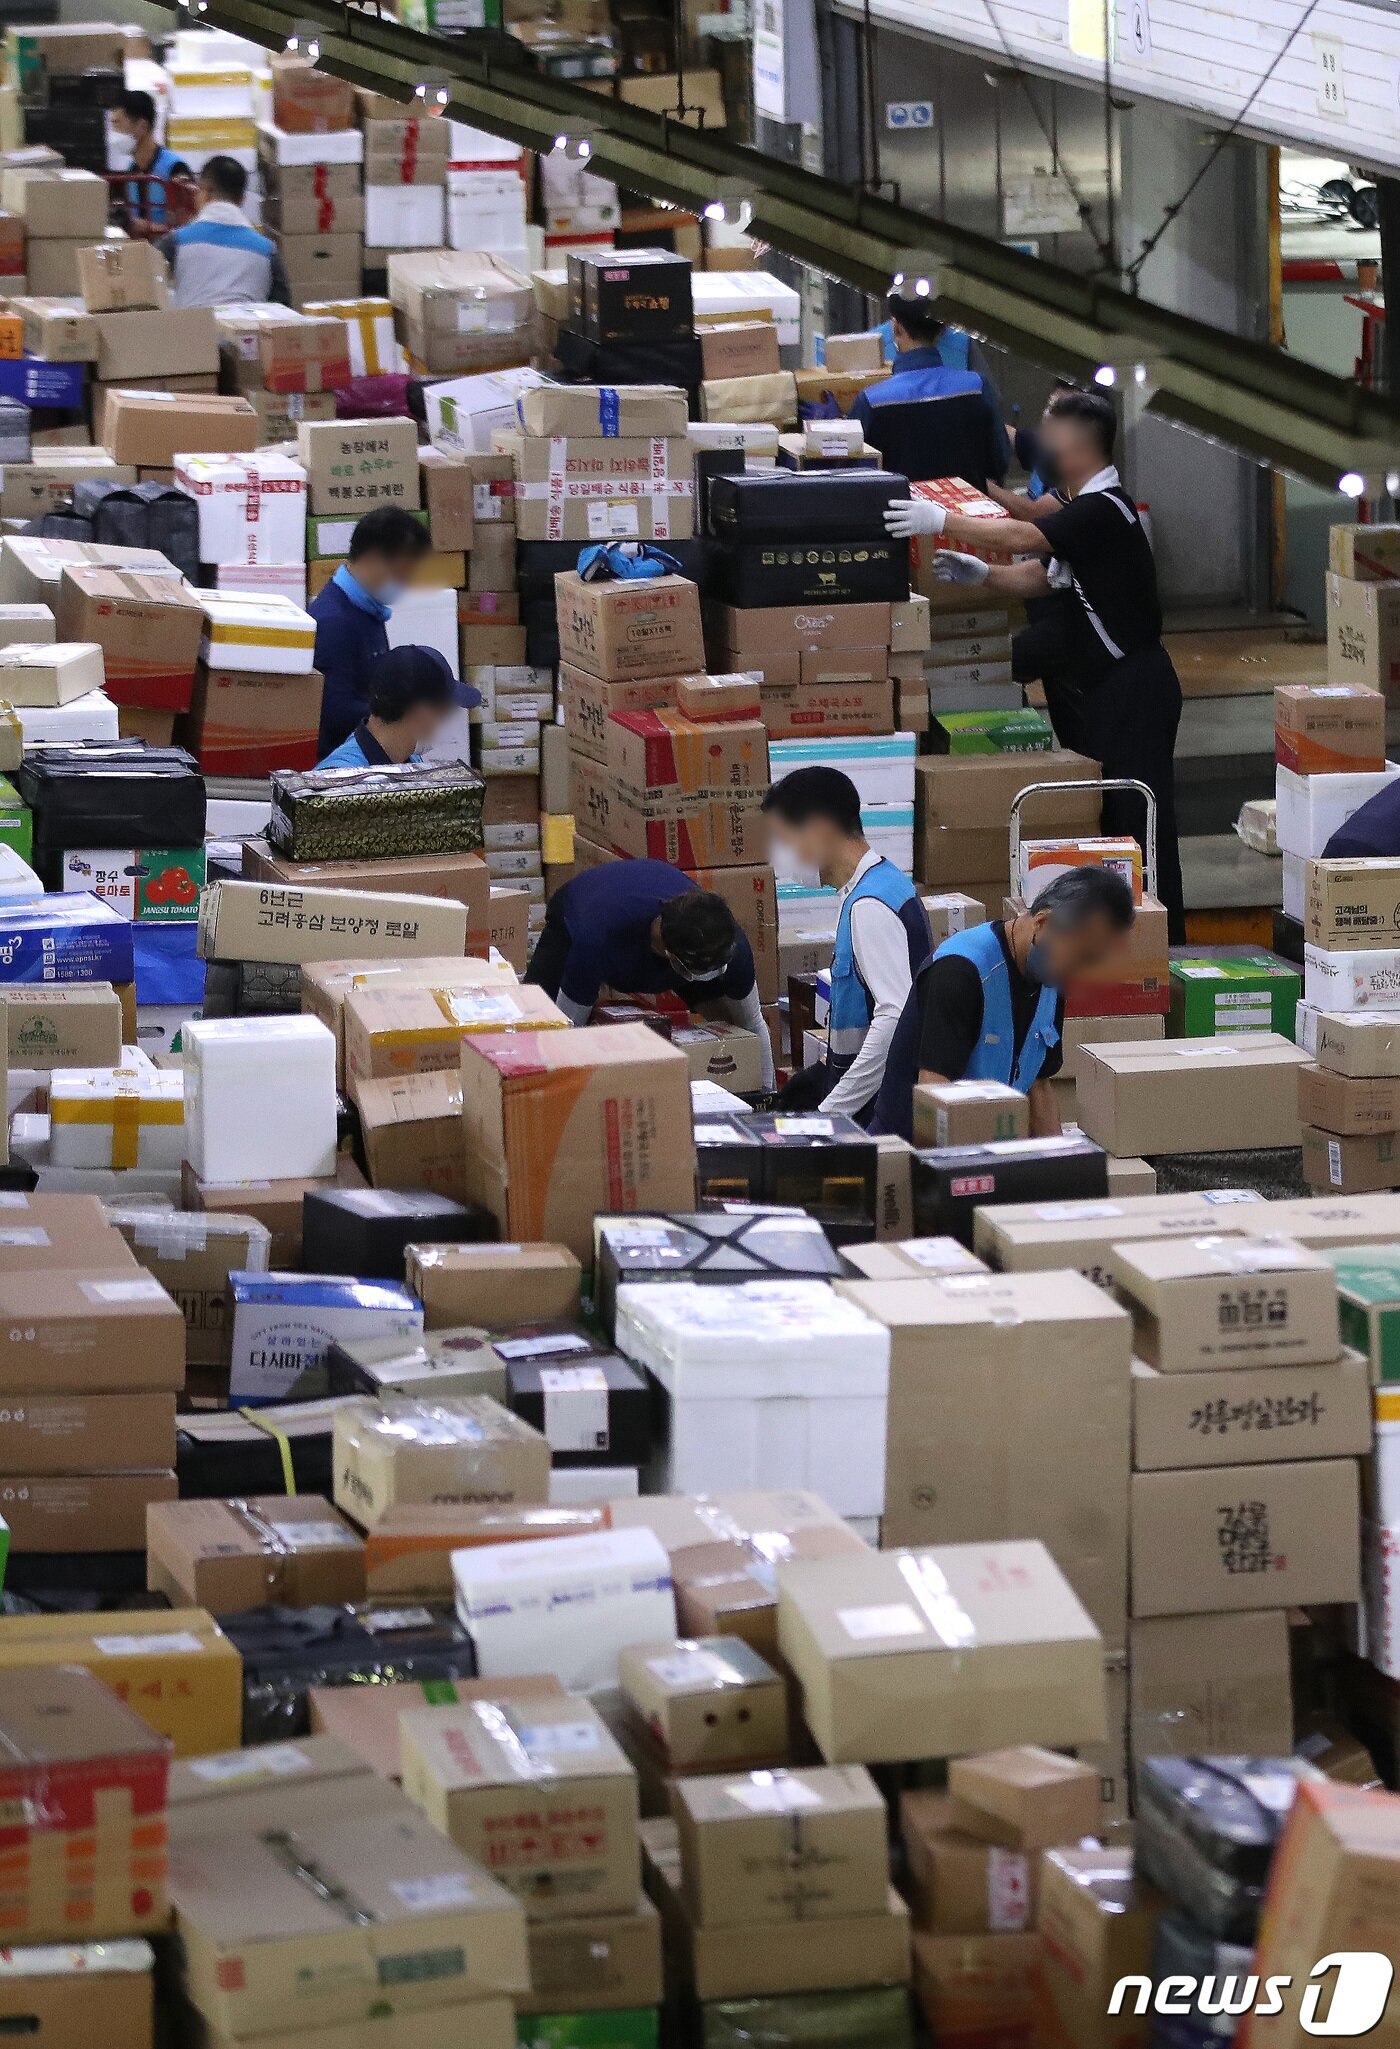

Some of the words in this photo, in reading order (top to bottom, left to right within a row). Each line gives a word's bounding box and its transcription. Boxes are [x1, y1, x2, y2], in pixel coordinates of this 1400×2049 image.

[341, 440, 389, 454] 농장에서
[569, 483, 614, 496] 당일배송
[117, 609, 143, 618] KOREA
[95, 870, 119, 883] 장수
[95, 885, 131, 896] 토마토
[260, 889, 304, 908] 6년근
[141, 906, 170, 915] JANGSU
[170, 906, 199, 914] TOMATO
[756, 899, 765, 928] KOREA
[1335, 904, 1367, 915] 고객님의
[258, 910, 325, 931] 고려홍삼
[329, 916, 379, 936] 보양정
[385, 921, 420, 940] 로얄
